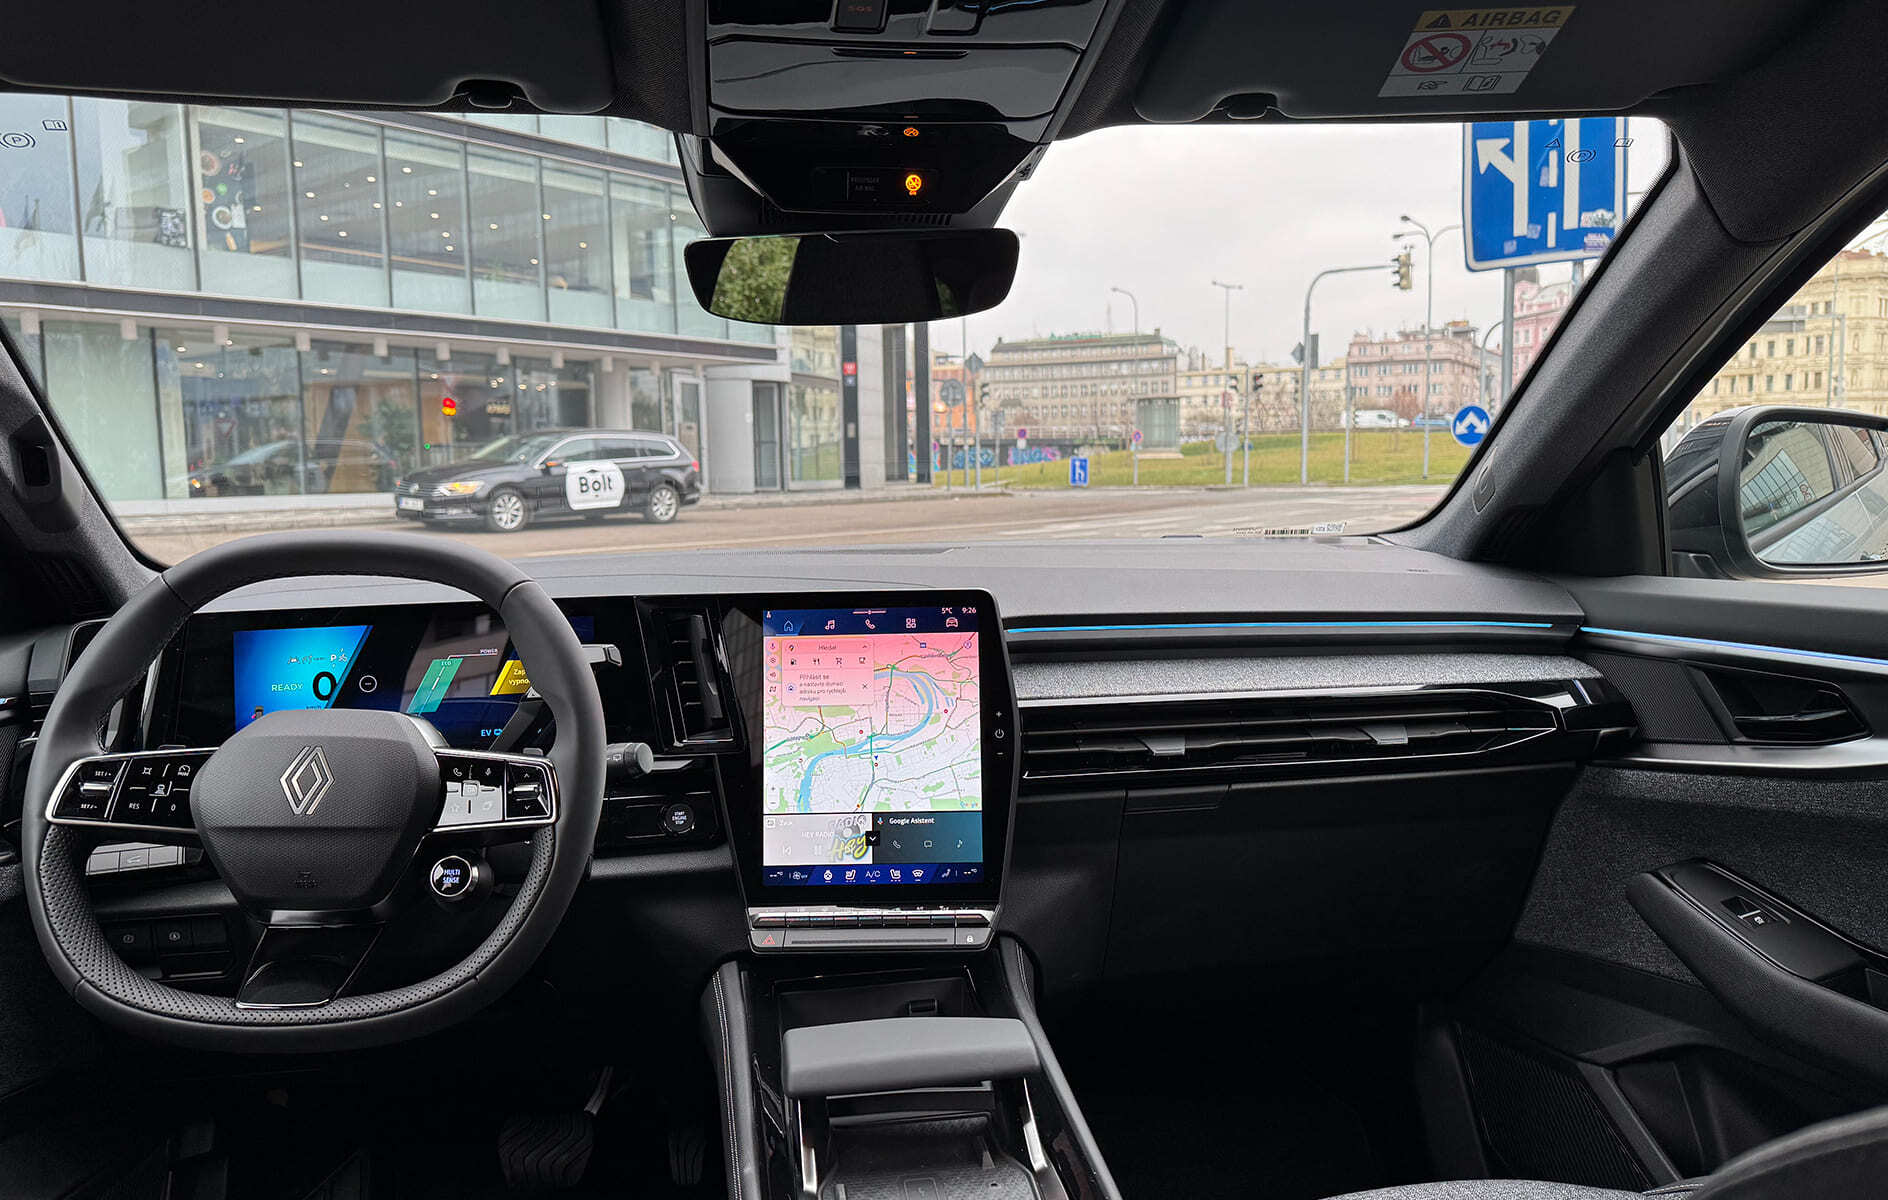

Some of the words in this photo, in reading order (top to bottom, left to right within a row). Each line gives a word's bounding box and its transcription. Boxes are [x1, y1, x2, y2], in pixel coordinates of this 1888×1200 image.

[1461, 10, 1561, 27] AIRBAG
[579, 474, 612, 493] Bolt
[271, 683, 304, 692] READY
[312, 671, 337, 701] 0
[480, 729, 492, 737] EV
[889, 817, 910, 826] Google
[865, 870, 881, 879] A/C
[442, 876, 460, 884] SENSE
